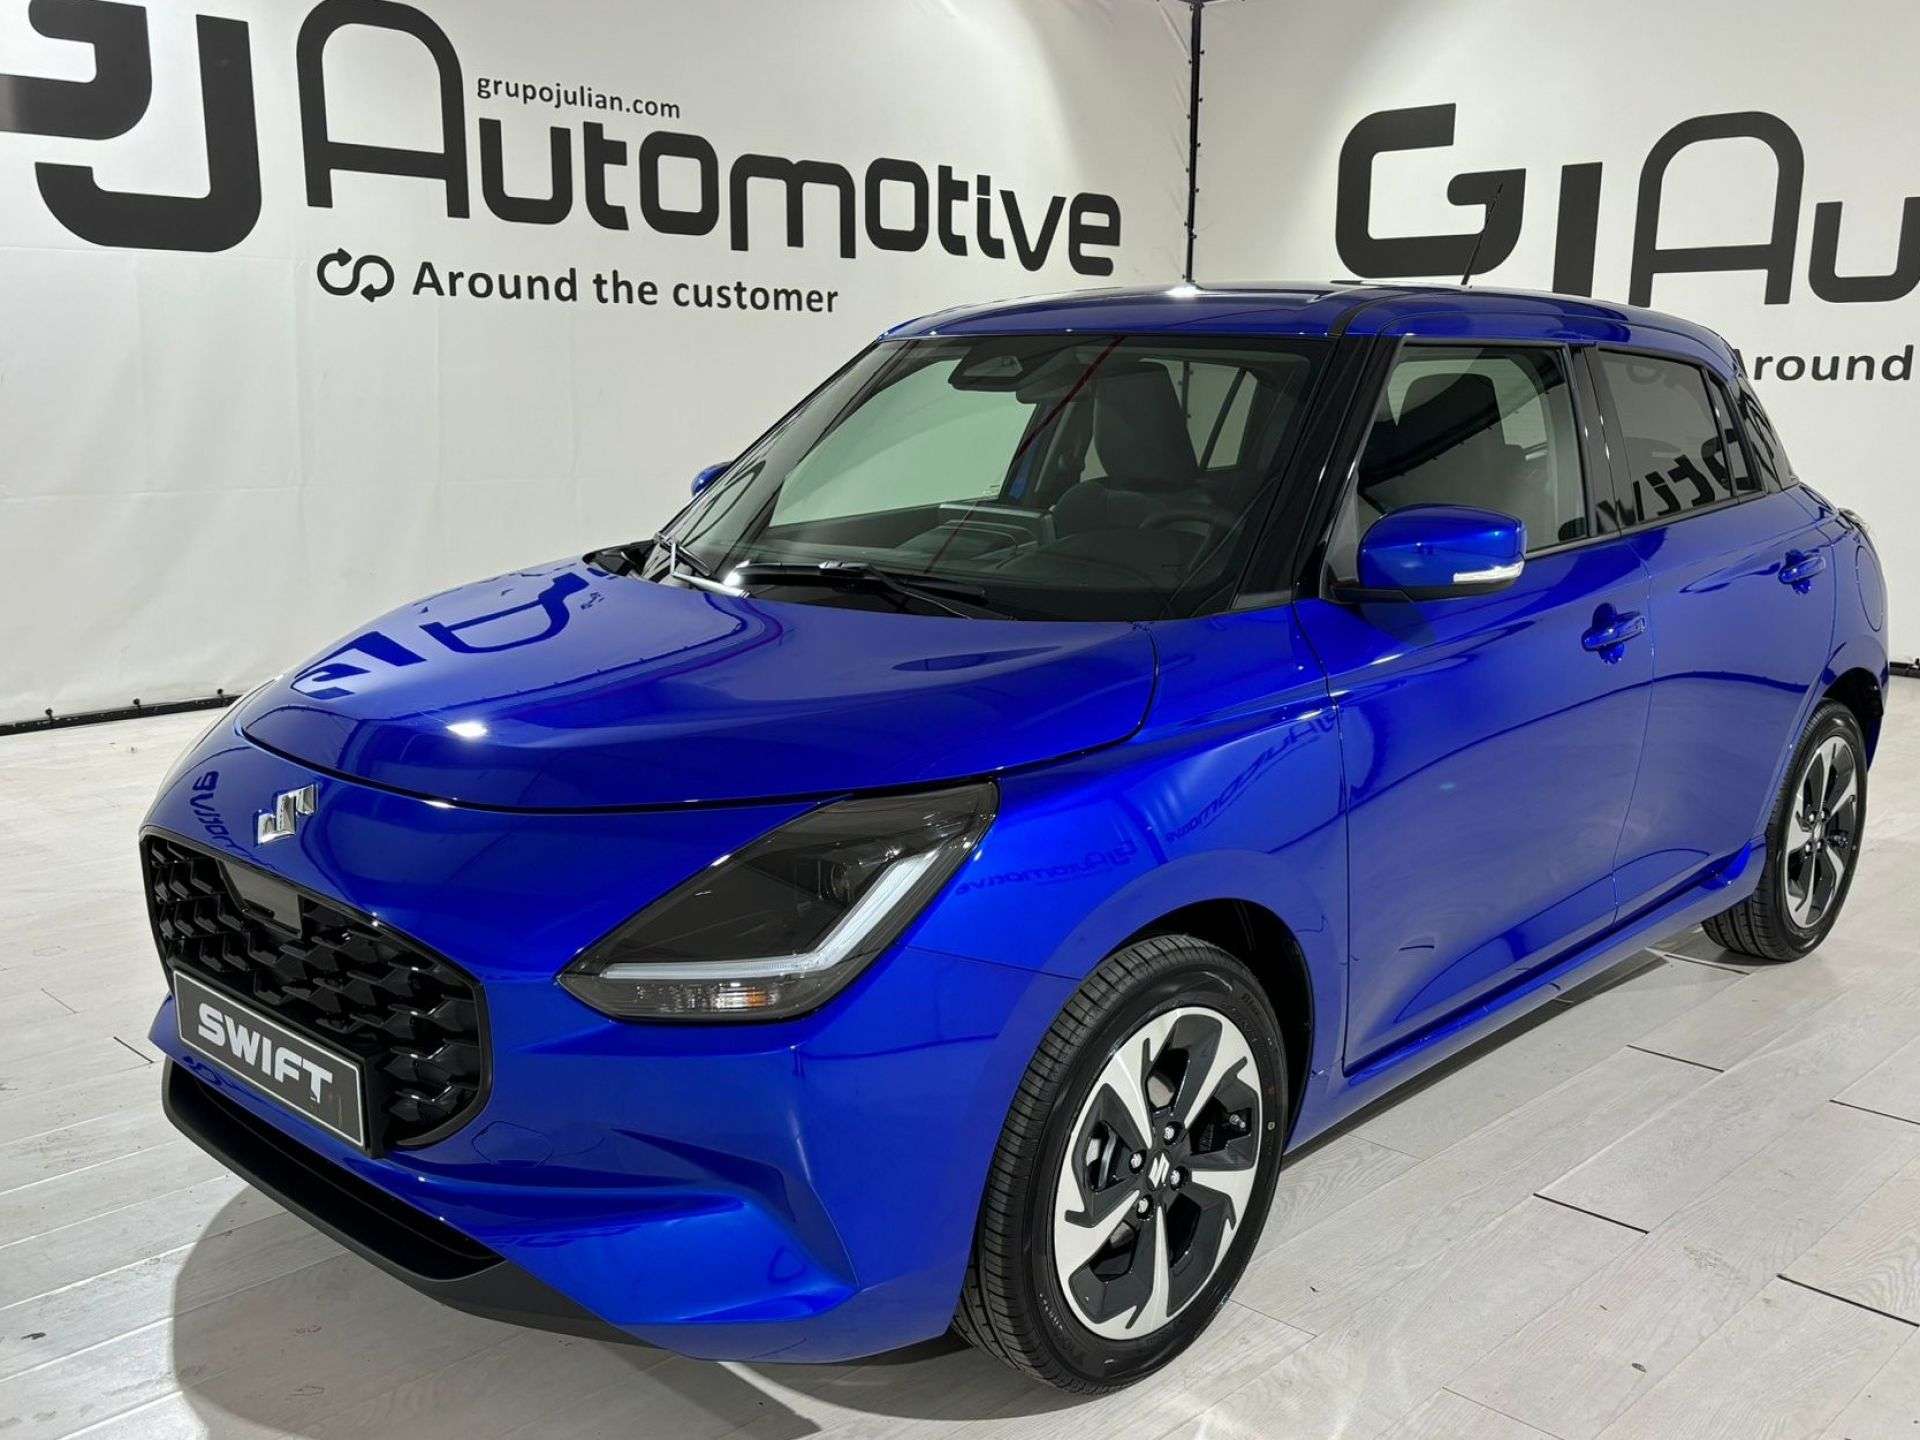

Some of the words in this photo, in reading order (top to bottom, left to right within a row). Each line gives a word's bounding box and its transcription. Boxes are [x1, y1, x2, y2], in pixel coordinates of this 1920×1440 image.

[477, 77, 680, 119] grupojulian.com
[412, 261, 578, 301] Around
[592, 269, 659, 306] the
[672, 281, 839, 313] customer
[1736, 344, 1914, 381] round
[198, 1003, 333, 1104] SWIFT
